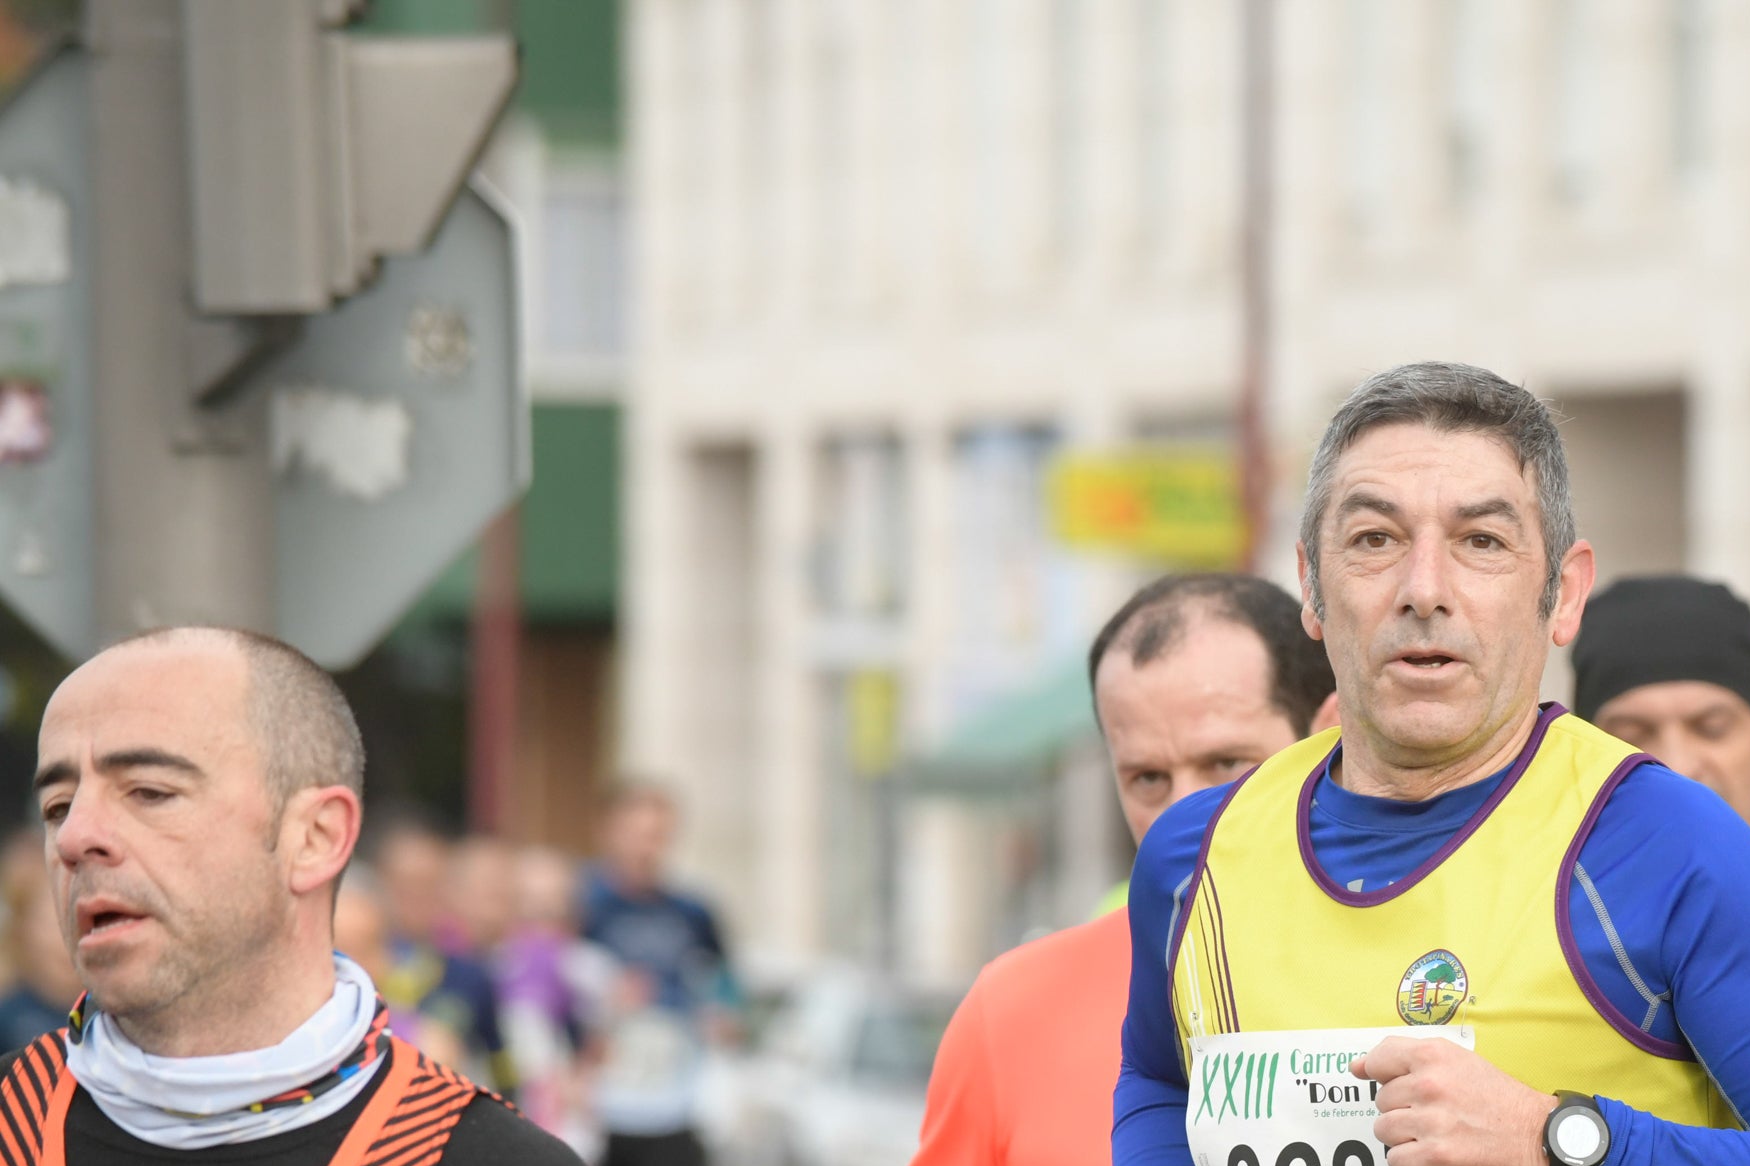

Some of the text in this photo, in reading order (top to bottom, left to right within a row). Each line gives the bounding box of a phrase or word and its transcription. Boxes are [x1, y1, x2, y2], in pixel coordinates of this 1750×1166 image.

[1194, 1051, 1279, 1126] XXIII
[1314, 1108, 1319, 1117] 9
[1321, 1107, 1331, 1117] de
[1332, 1107, 1364, 1117] febrero
[1366, 1107, 1376, 1117] de
